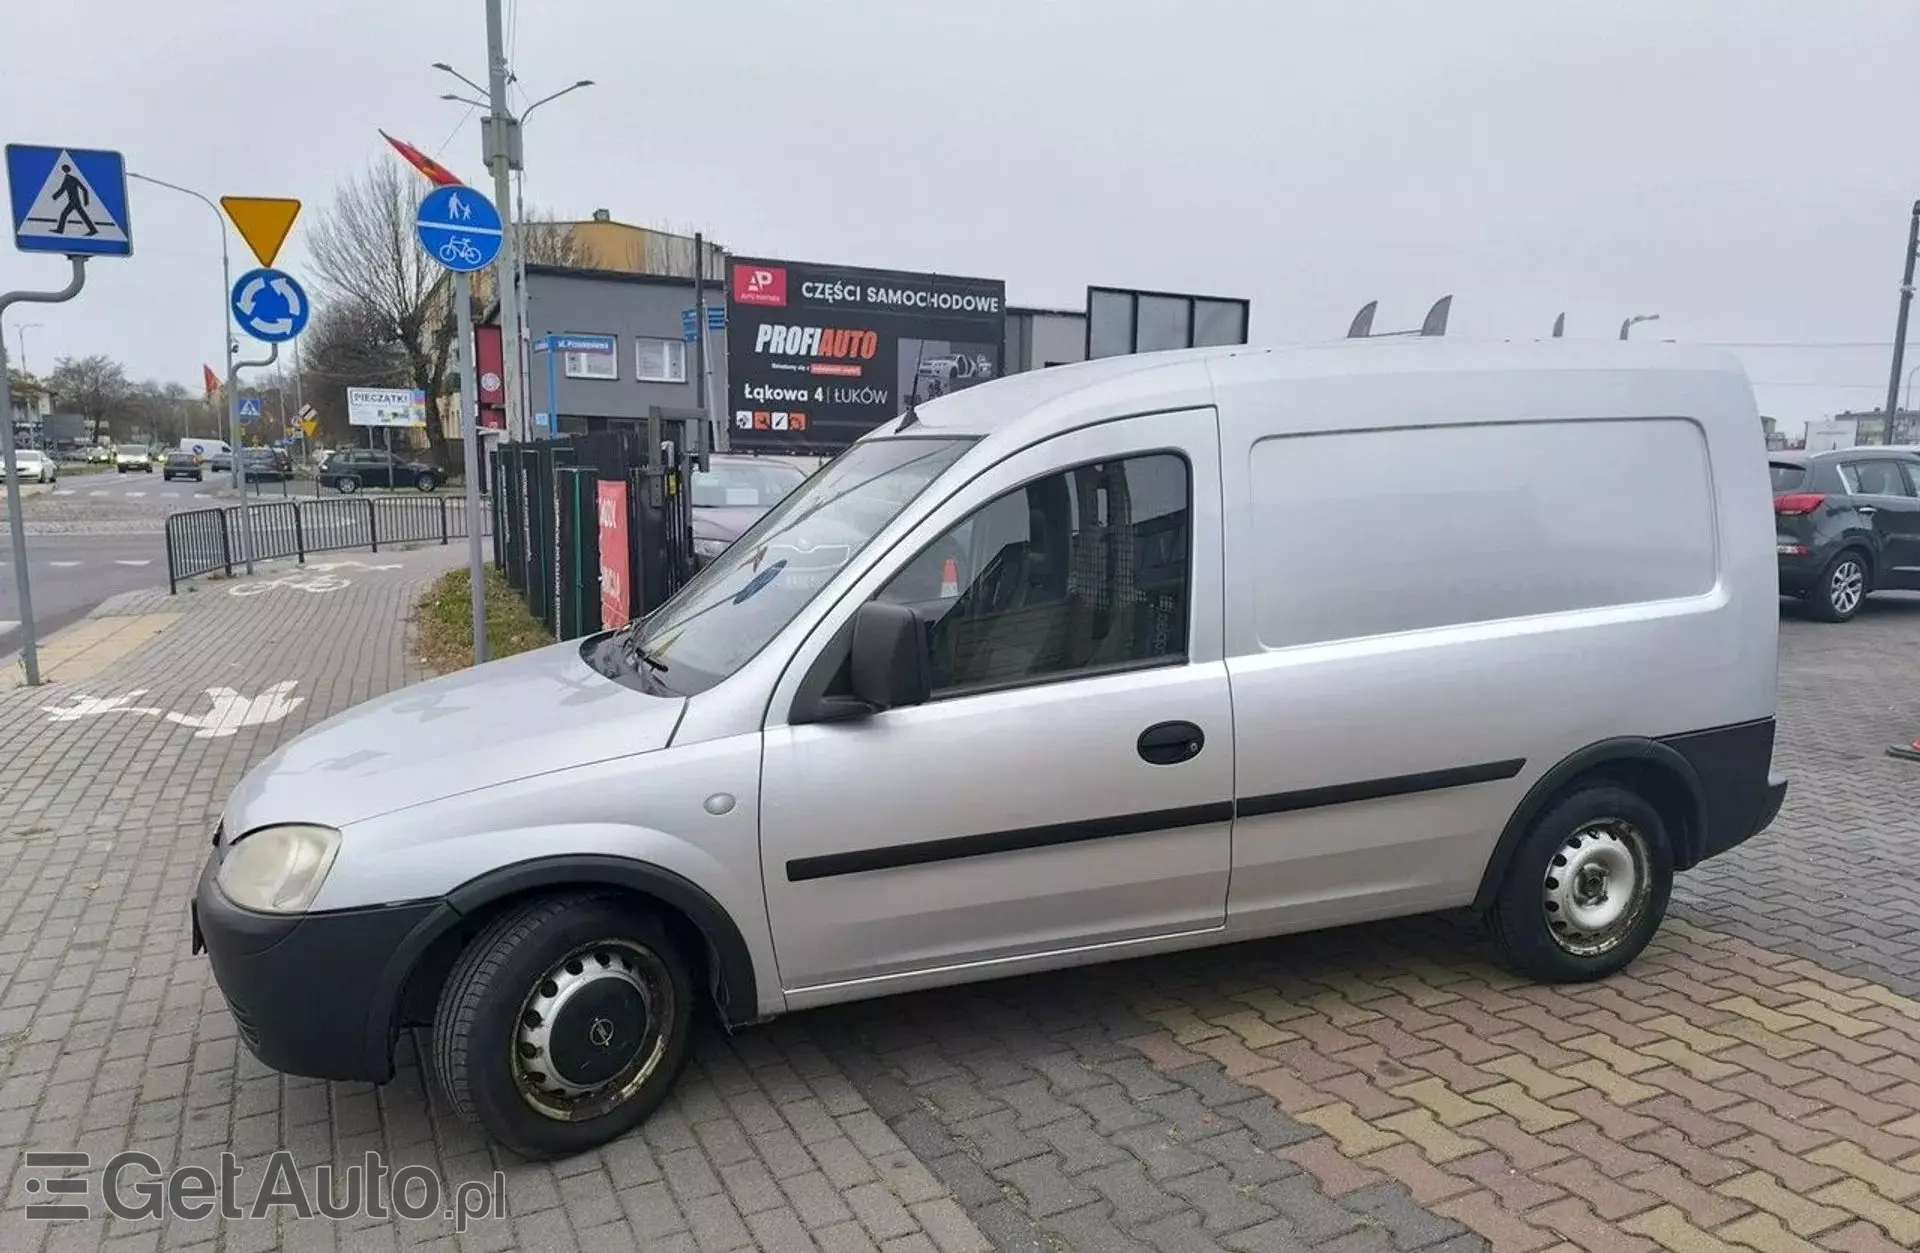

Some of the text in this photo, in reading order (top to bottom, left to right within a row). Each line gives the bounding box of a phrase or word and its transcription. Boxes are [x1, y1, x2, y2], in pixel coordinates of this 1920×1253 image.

[801, 280, 861, 303] CZĘŚCI
[866, 287, 999, 313] SAMOCHODOWE
[755, 323, 878, 360] PROFIAUTO
[744, 383, 888, 405] Łąkowa 4 ŁUKÓW
